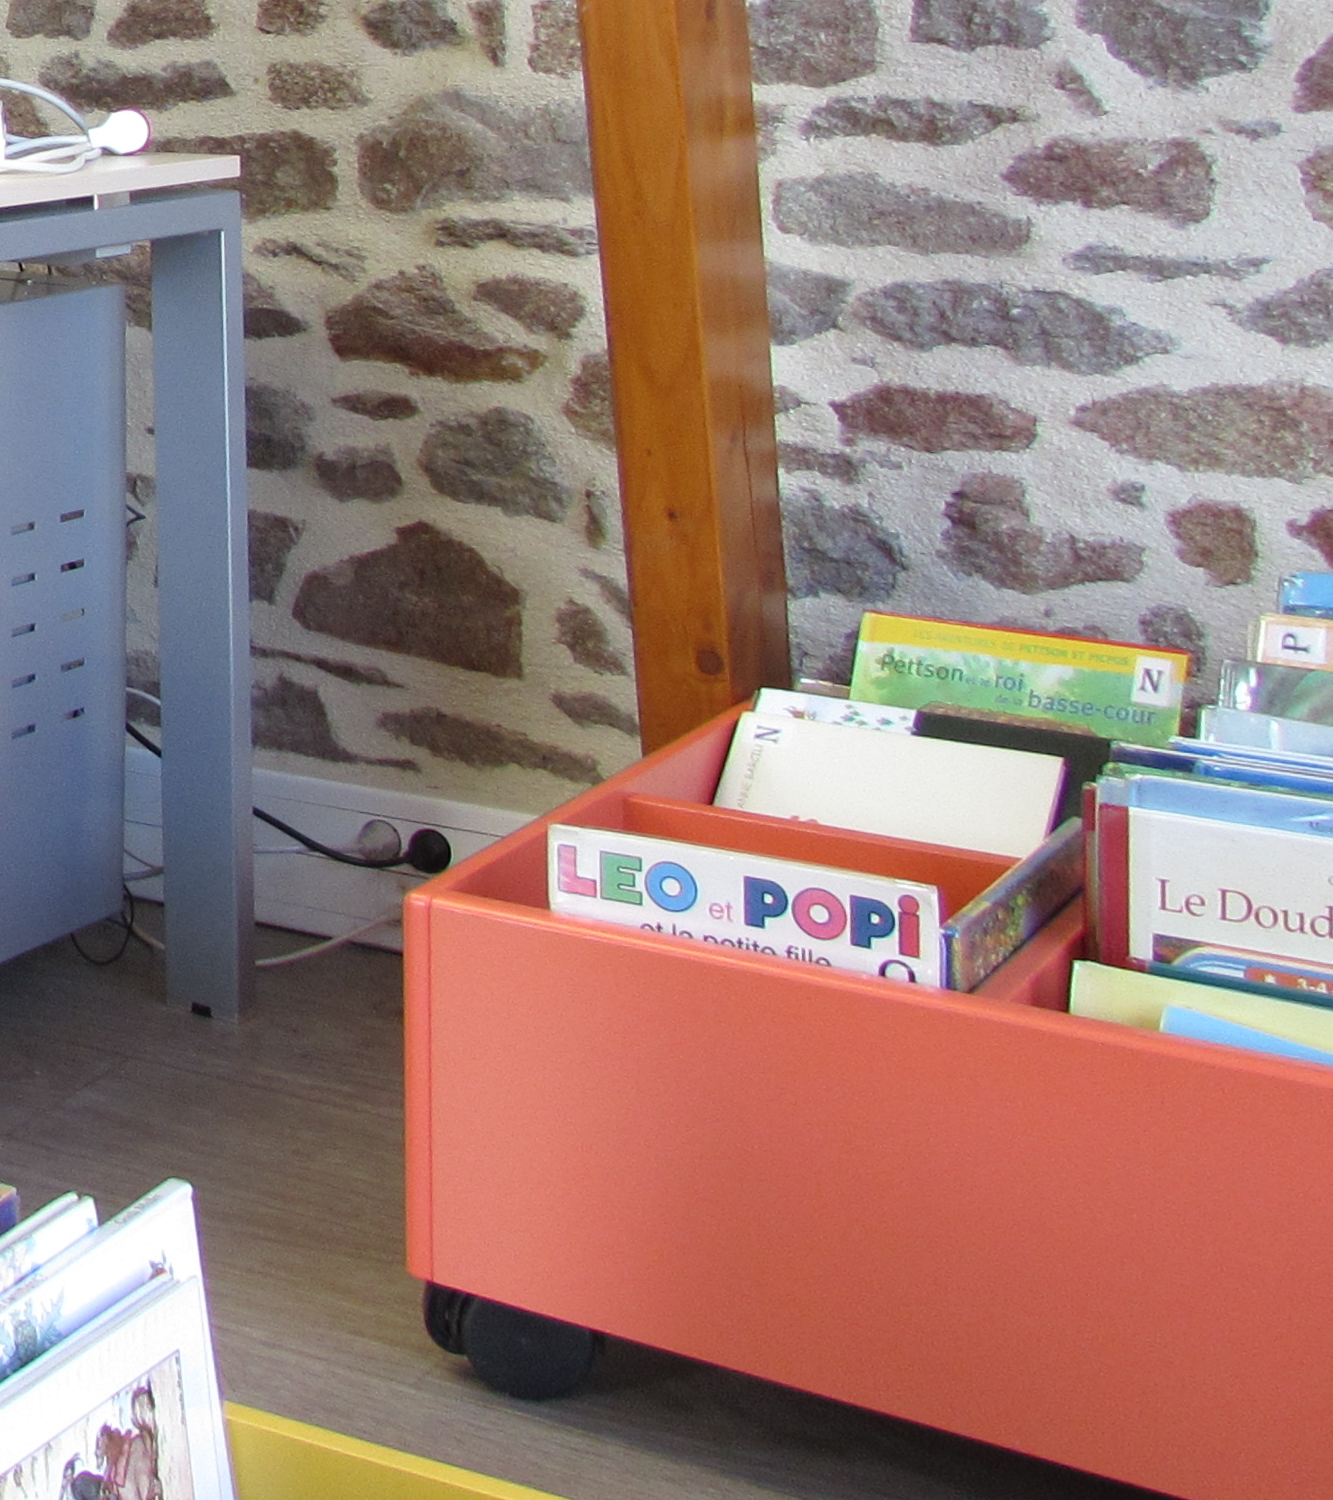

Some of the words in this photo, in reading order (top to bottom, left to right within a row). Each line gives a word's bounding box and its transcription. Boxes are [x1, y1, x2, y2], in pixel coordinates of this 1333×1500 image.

[1281, 633, 1311, 653] P
[881, 650, 964, 683] Pettson
[995, 672, 1025, 692] roi
[1139, 668, 1164, 694] N
[1028, 688, 1157, 727] basse-cour
[557, 844, 698, 912] LEO
[708, 902, 734, 922] et
[1155, 878, 1207, 918] Le
